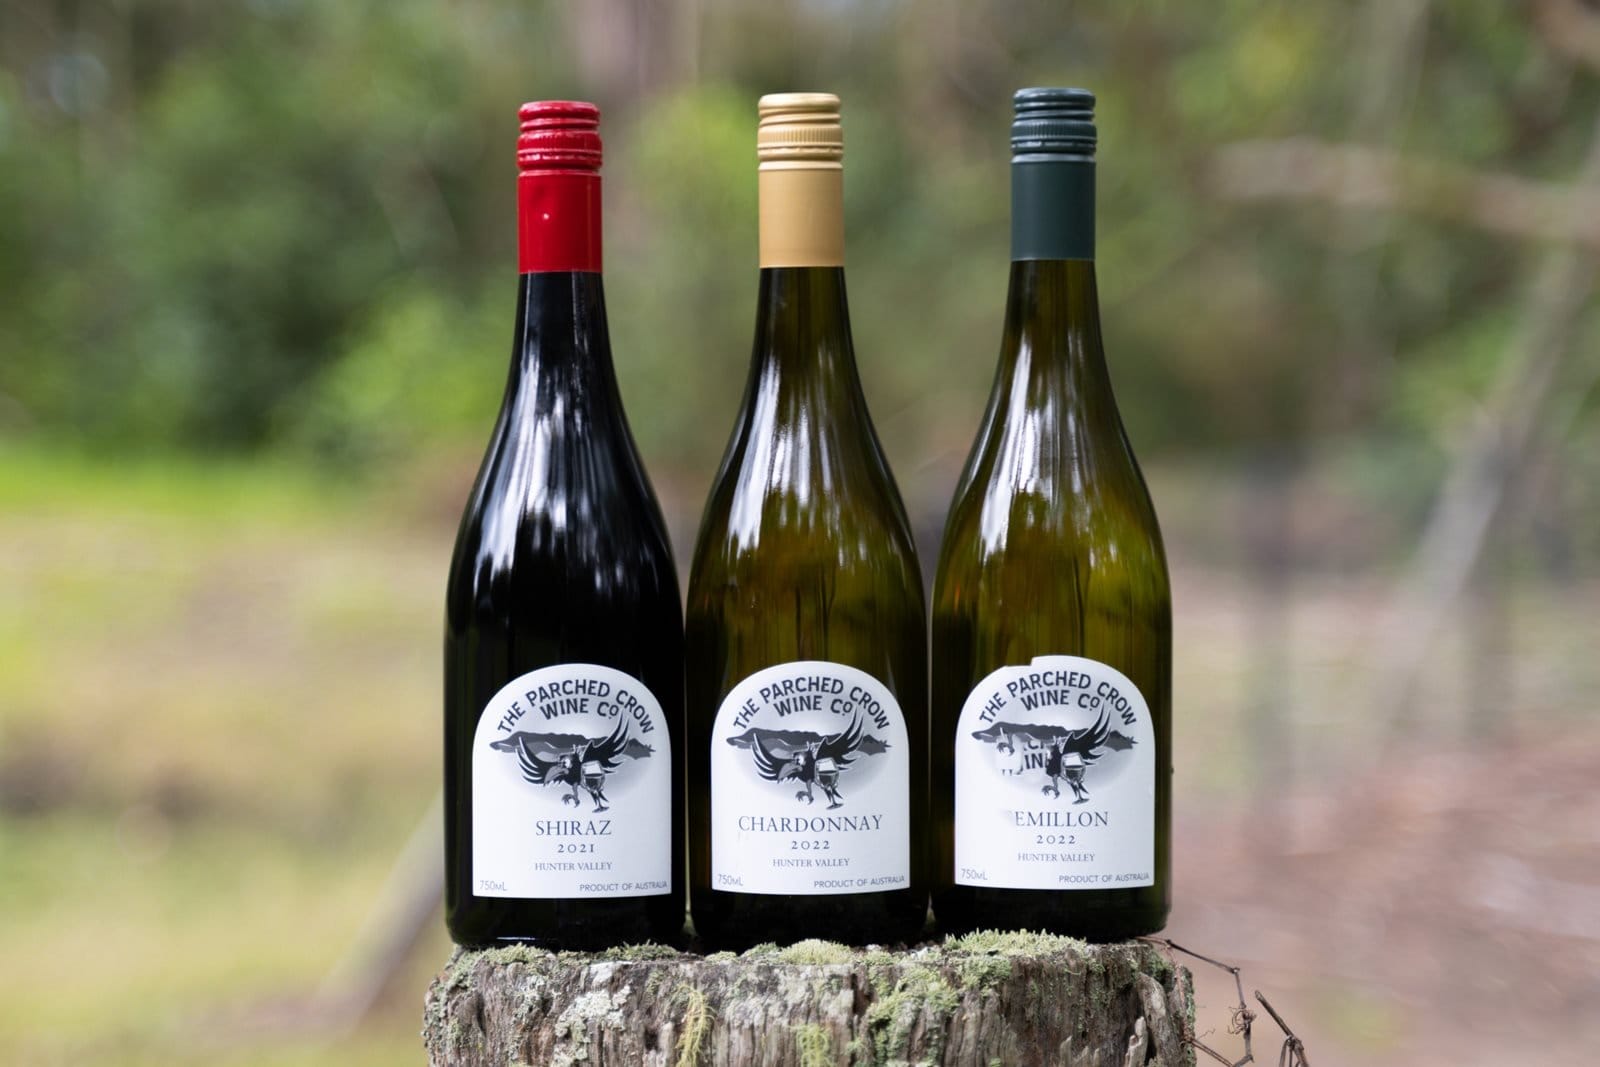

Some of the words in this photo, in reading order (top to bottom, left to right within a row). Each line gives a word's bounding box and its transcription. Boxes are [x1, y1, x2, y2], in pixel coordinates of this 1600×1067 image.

[733, 698, 760, 729] THE
[761, 676, 843, 704] PARCHED
[850, 686, 890, 729] CROW
[979, 692, 1007, 723] THE
[1007, 671, 1091, 698] PARCHED
[1097, 681, 1136, 725] CROW
[1021, 690, 1069, 711] WINE
[498, 702, 526, 734] THE
[525, 679, 609, 706] PARCHED
[616, 690, 655, 734] CROW
[540, 698, 588, 720] WINE
[773, 696, 822, 717] WINE
[738, 815, 883, 833] CHARDONNAY
[1008, 811, 1109, 827] EMILLON
[536, 820, 612, 836] SHIRAZ
[792, 840, 830, 850] 2022
[1037, 835, 1076, 845] 2022
[557, 844, 594, 853] 2021
[773, 859, 812, 867] HUNTER
[815, 858, 850, 867] VALLEY
[1018, 853, 1057, 862] HUNTER
[1060, 853, 1095, 862] VALLEY
[535, 863, 575, 871] HUNTER
[577, 862, 612, 871] VALLEY
[635, 881, 667, 889] AUSTRALIA
[814, 880, 854, 888] PRODUCT
[870, 875, 904, 886] AUSTRALIA
[1059, 875, 1099, 883] PRODUCT
[1115, 873, 1149, 881] AUSTRALIA
